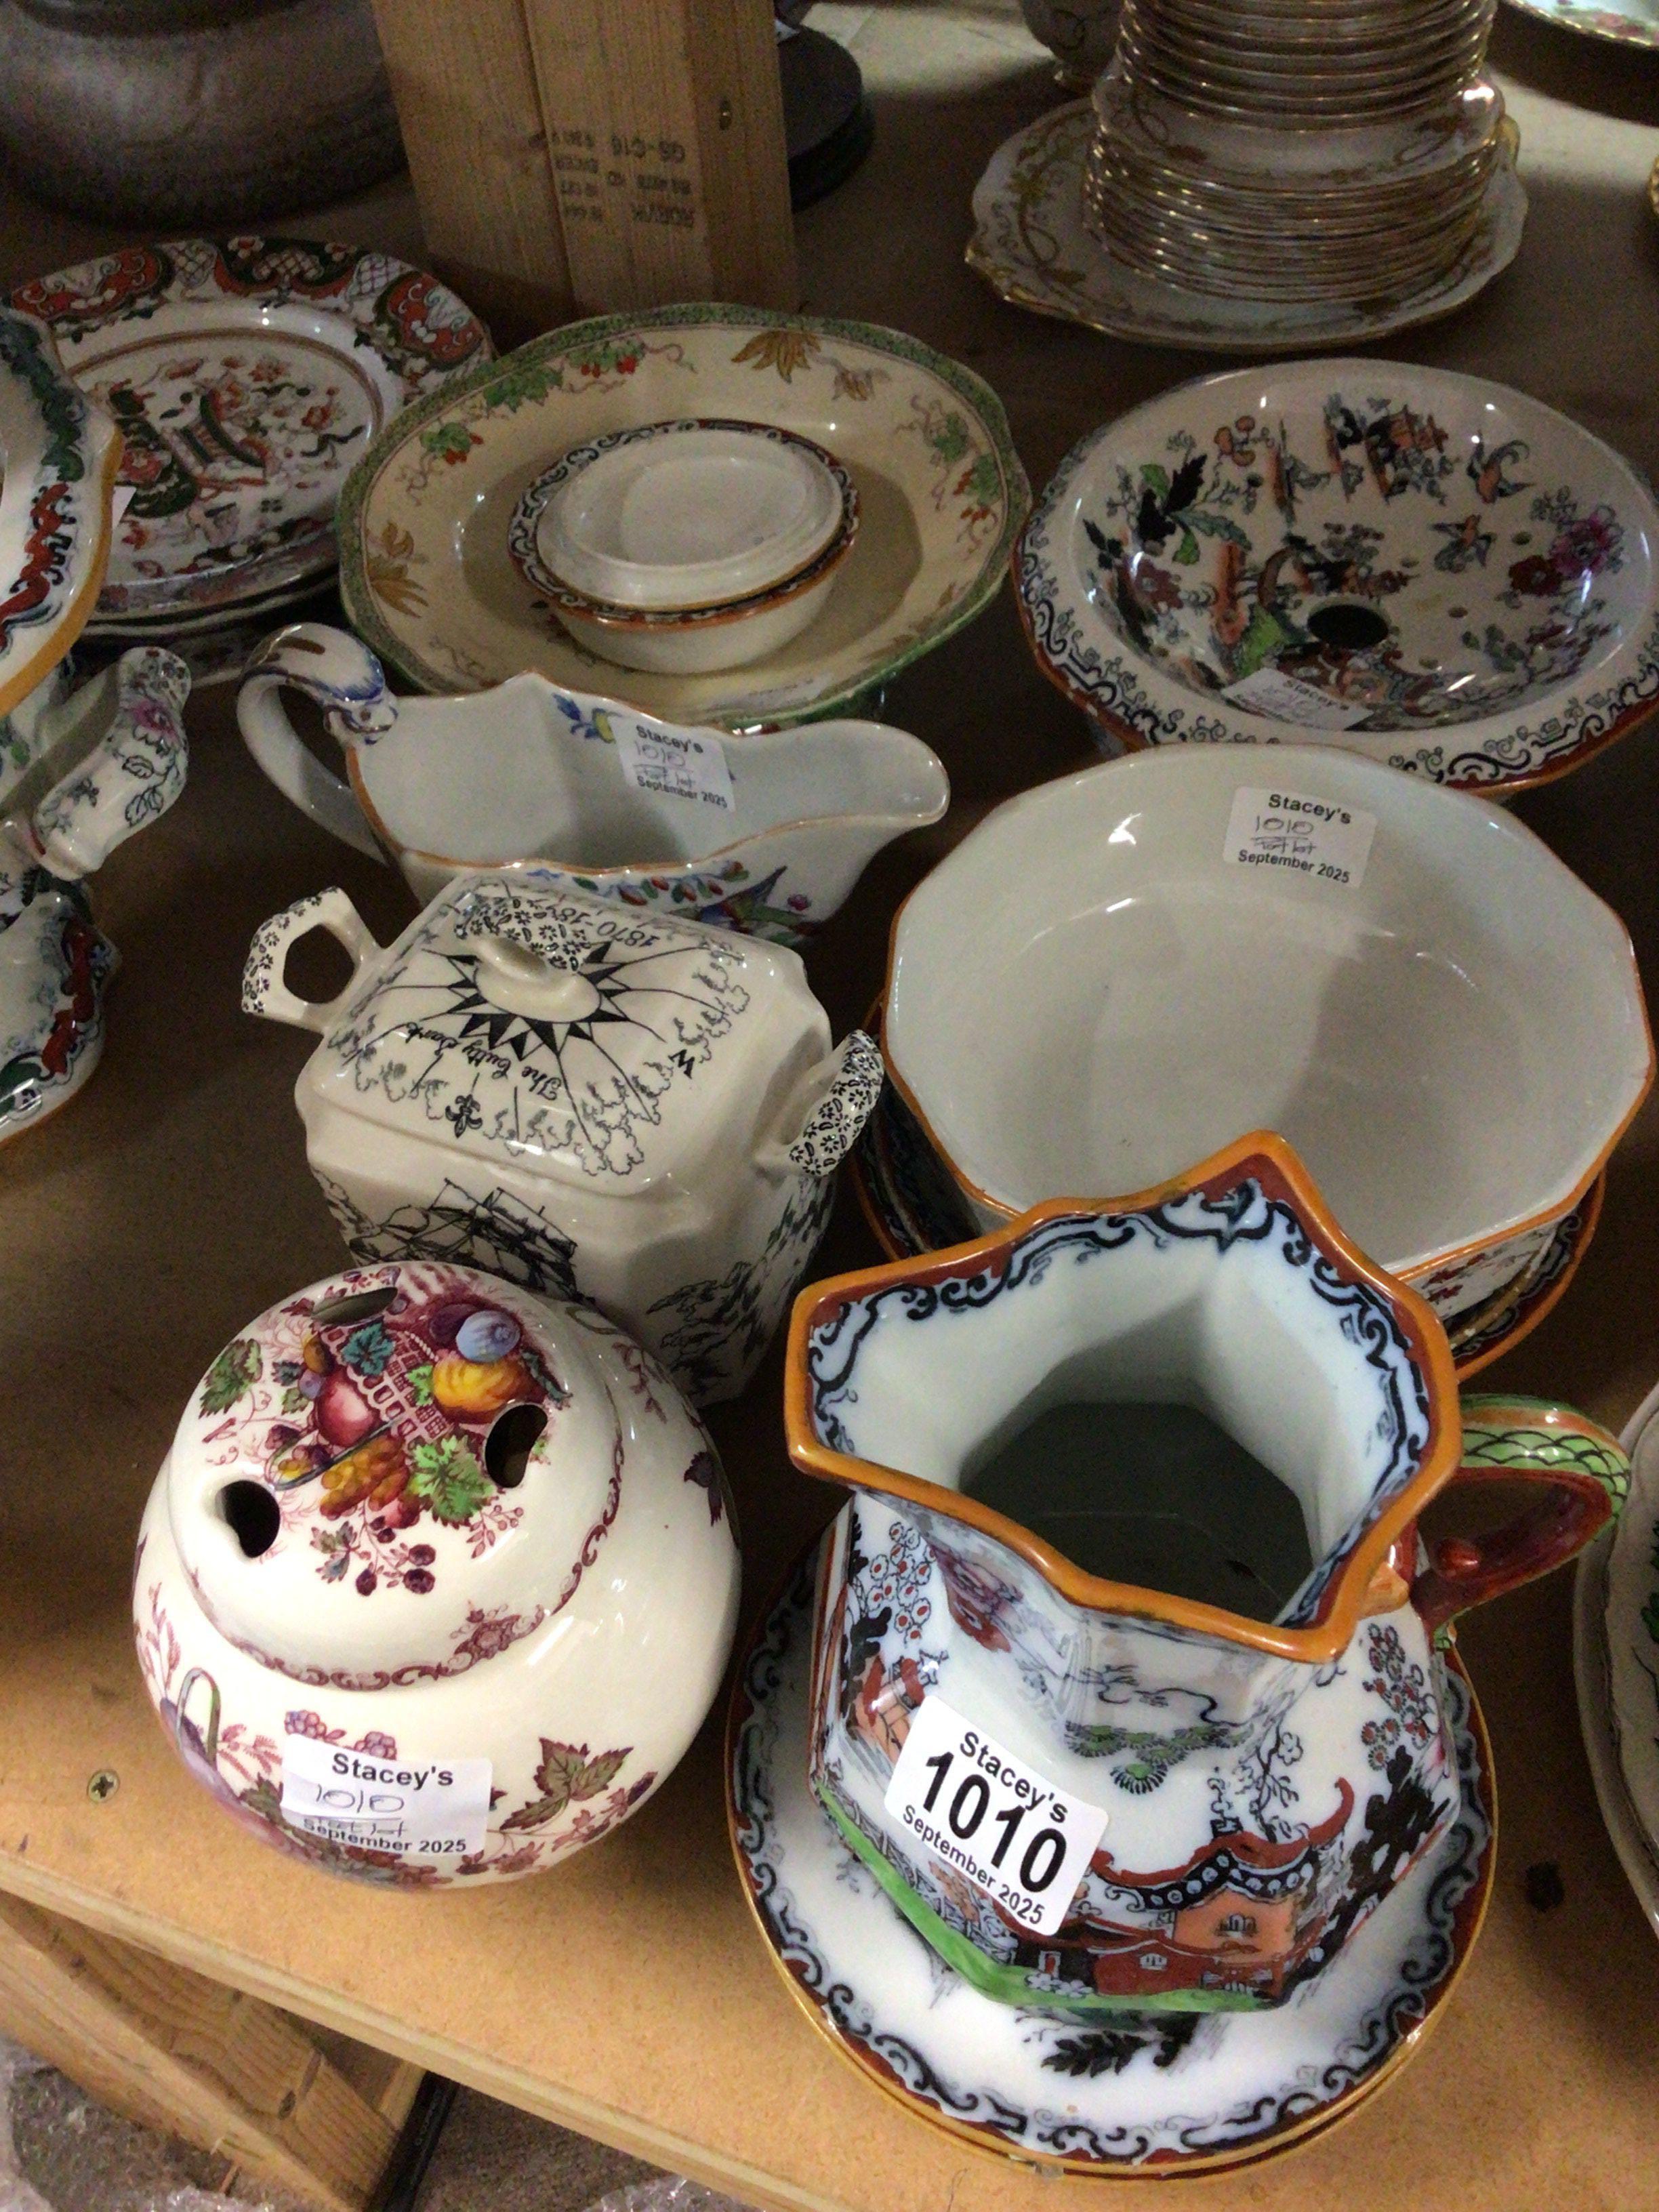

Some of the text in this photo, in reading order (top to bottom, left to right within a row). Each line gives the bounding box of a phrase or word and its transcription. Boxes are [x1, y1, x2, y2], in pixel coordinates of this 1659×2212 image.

[634, 740, 686, 766] 1010
[635, 724, 703, 754] Stacey's
[636, 775, 728, 809] September 2025
[1267, 793, 1352, 825] Stacey's
[1255, 815, 1315, 835] 1010
[1238, 848, 1351, 884] September 2025
[404, 1021, 562, 1101] The Cutty Sark
[331, 1753, 453, 1790] Stacey's
[960, 1731, 1069, 1824] Stacey's
[315, 1783, 405, 1814] 1010
[303, 1818, 467, 1854] September 2025
[922, 1750, 1067, 1893] 1010
[902, 1804, 1045, 1925] September 2025
